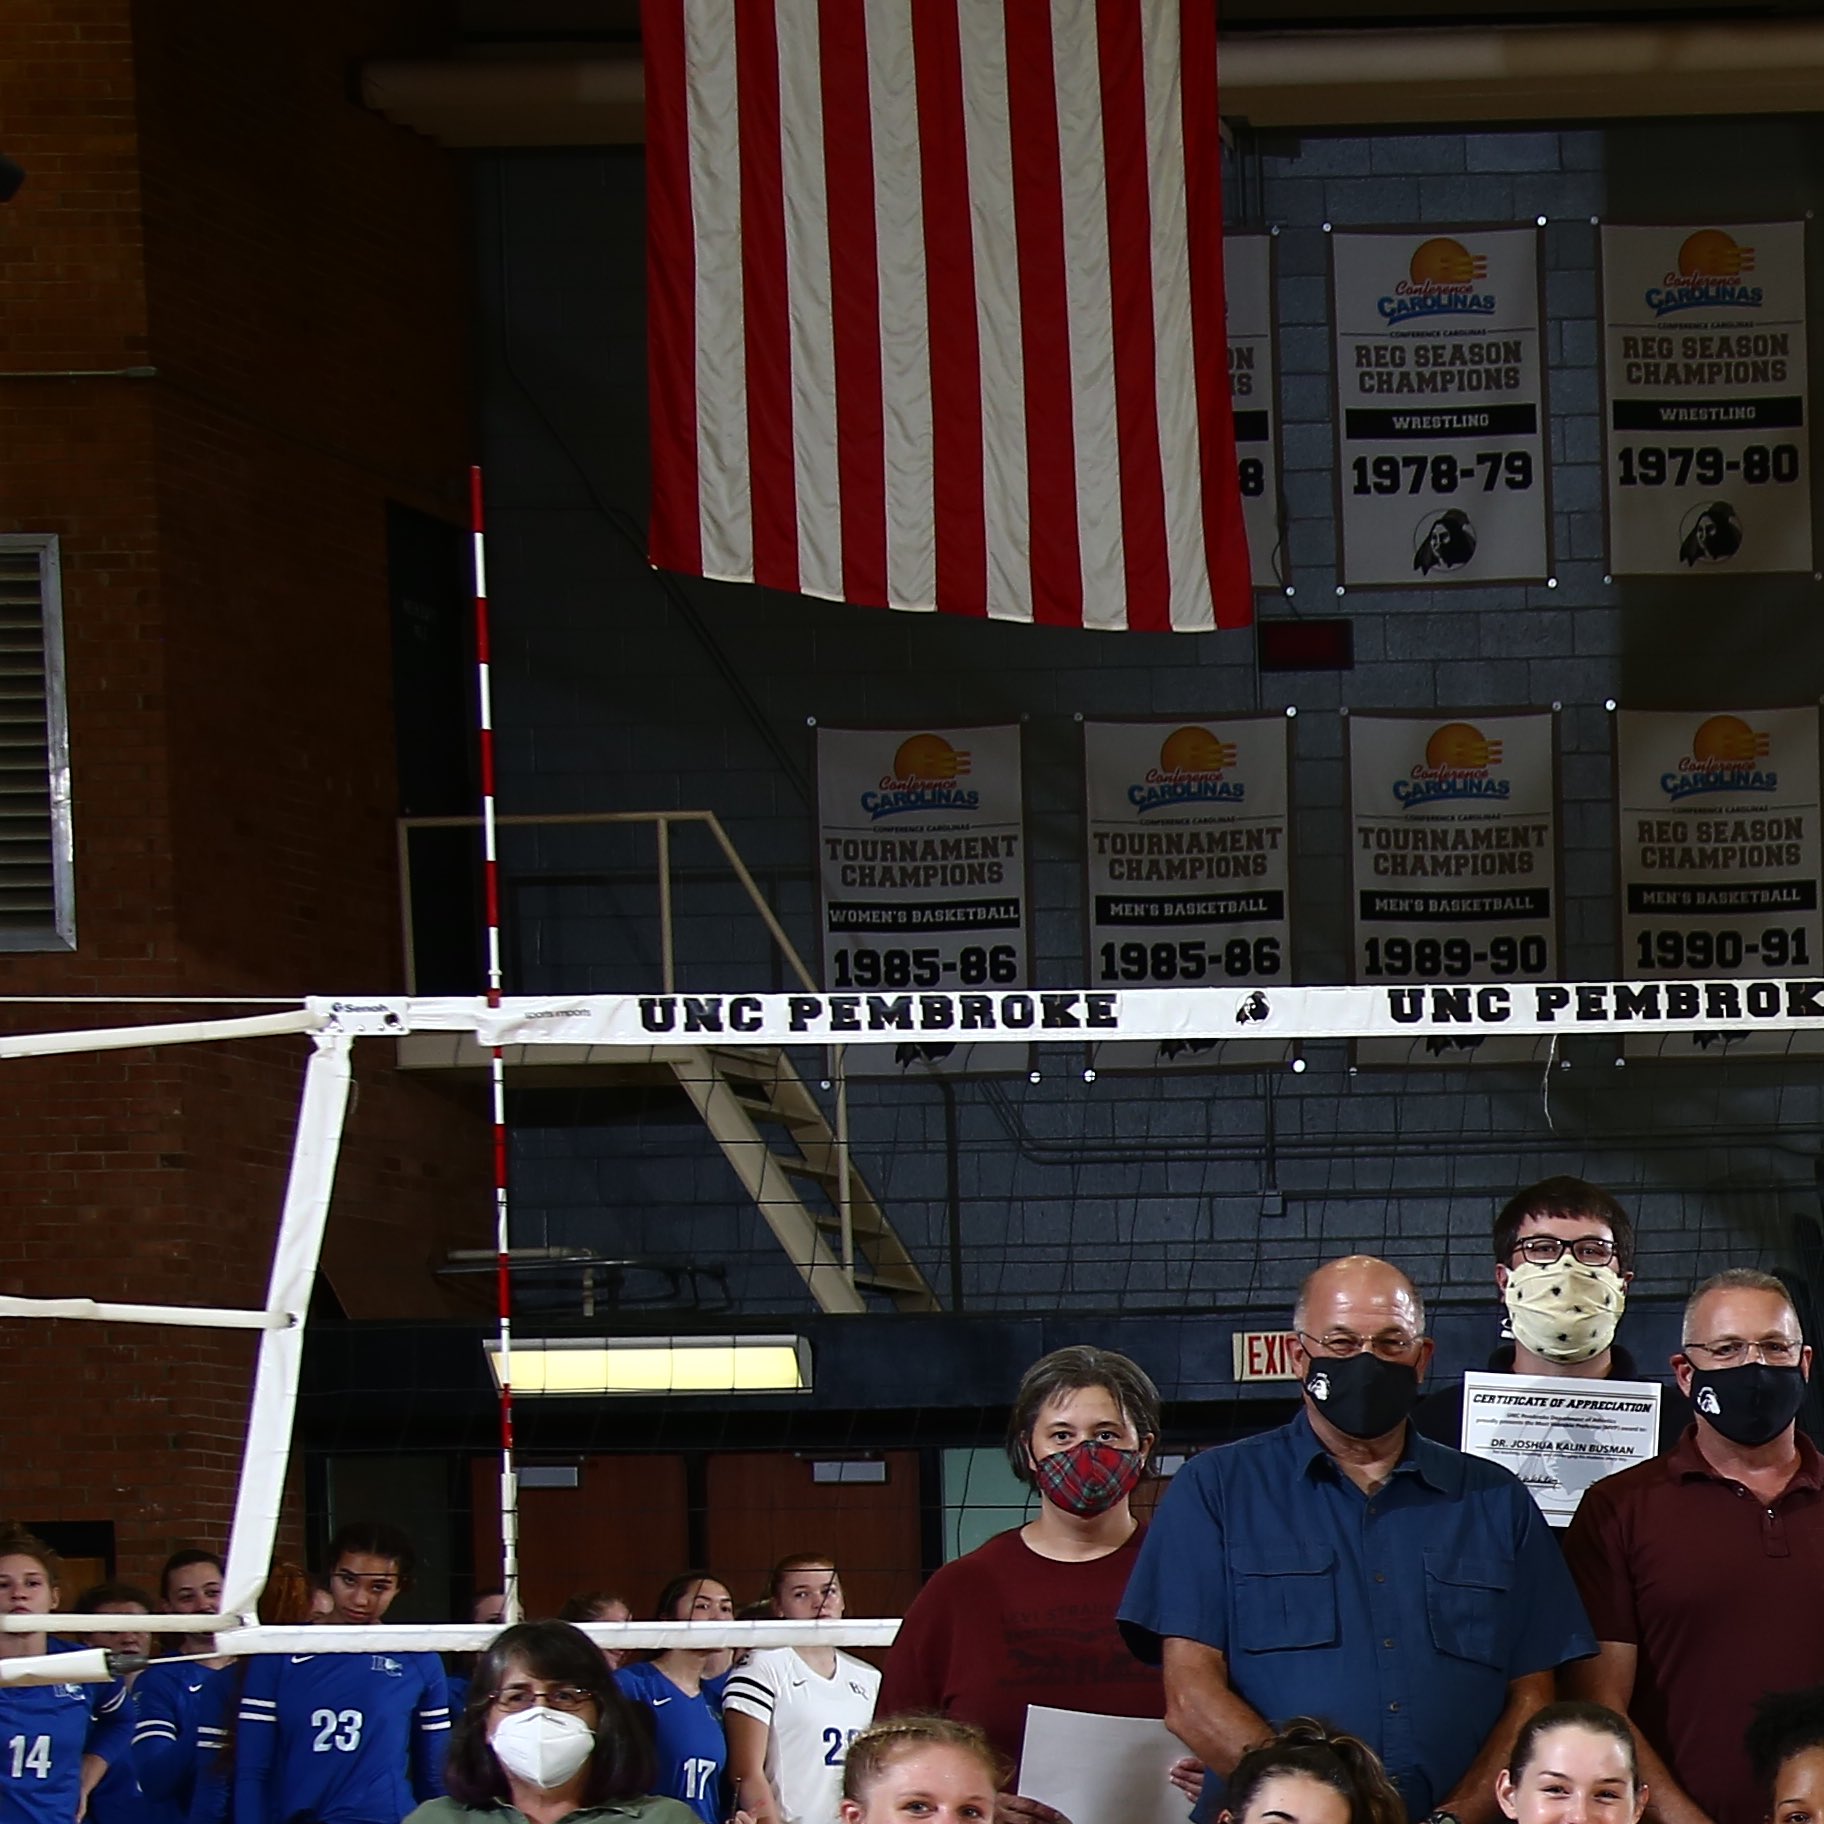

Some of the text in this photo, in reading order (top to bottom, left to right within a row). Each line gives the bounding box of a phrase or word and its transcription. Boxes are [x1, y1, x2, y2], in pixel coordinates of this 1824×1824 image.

[1377, 293, 1495, 318] CAROLINAS
[1356, 341, 1522, 368] REG SEASON
[1358, 366, 1521, 394] CHAMPIONS
[1392, 413, 1489, 431] WRESTLING
[1352, 450, 1533, 496] 1978-79
[1618, 444, 1799, 487] 1979-80
[825, 835, 1019, 863] TOURNAMENT
[840, 861, 1004, 889] CHAMPIONS
[829, 904, 1020, 926] WOMEN'S BASKETBALL
[1100, 937, 1282, 981] 1985-86
[1365, 935, 1547, 977] 1989-90
[1636, 926, 1810, 969] 1990-91
[833, 946, 1017, 989] 1985-86
[638, 993, 1119, 1033] UNC PEMBROKE
[1389, 987, 1509, 1024] UNC
[1473, 1394, 1652, 1413] CERTIFICATE OF APPRECIATION
[1491, 1438, 1634, 1455] DR. JOSHUA KALIN BUSMAN
[310, 1709, 363, 1753] 23
[9, 1735, 52, 1779] 14
[684, 1758, 717, 1800] 17
